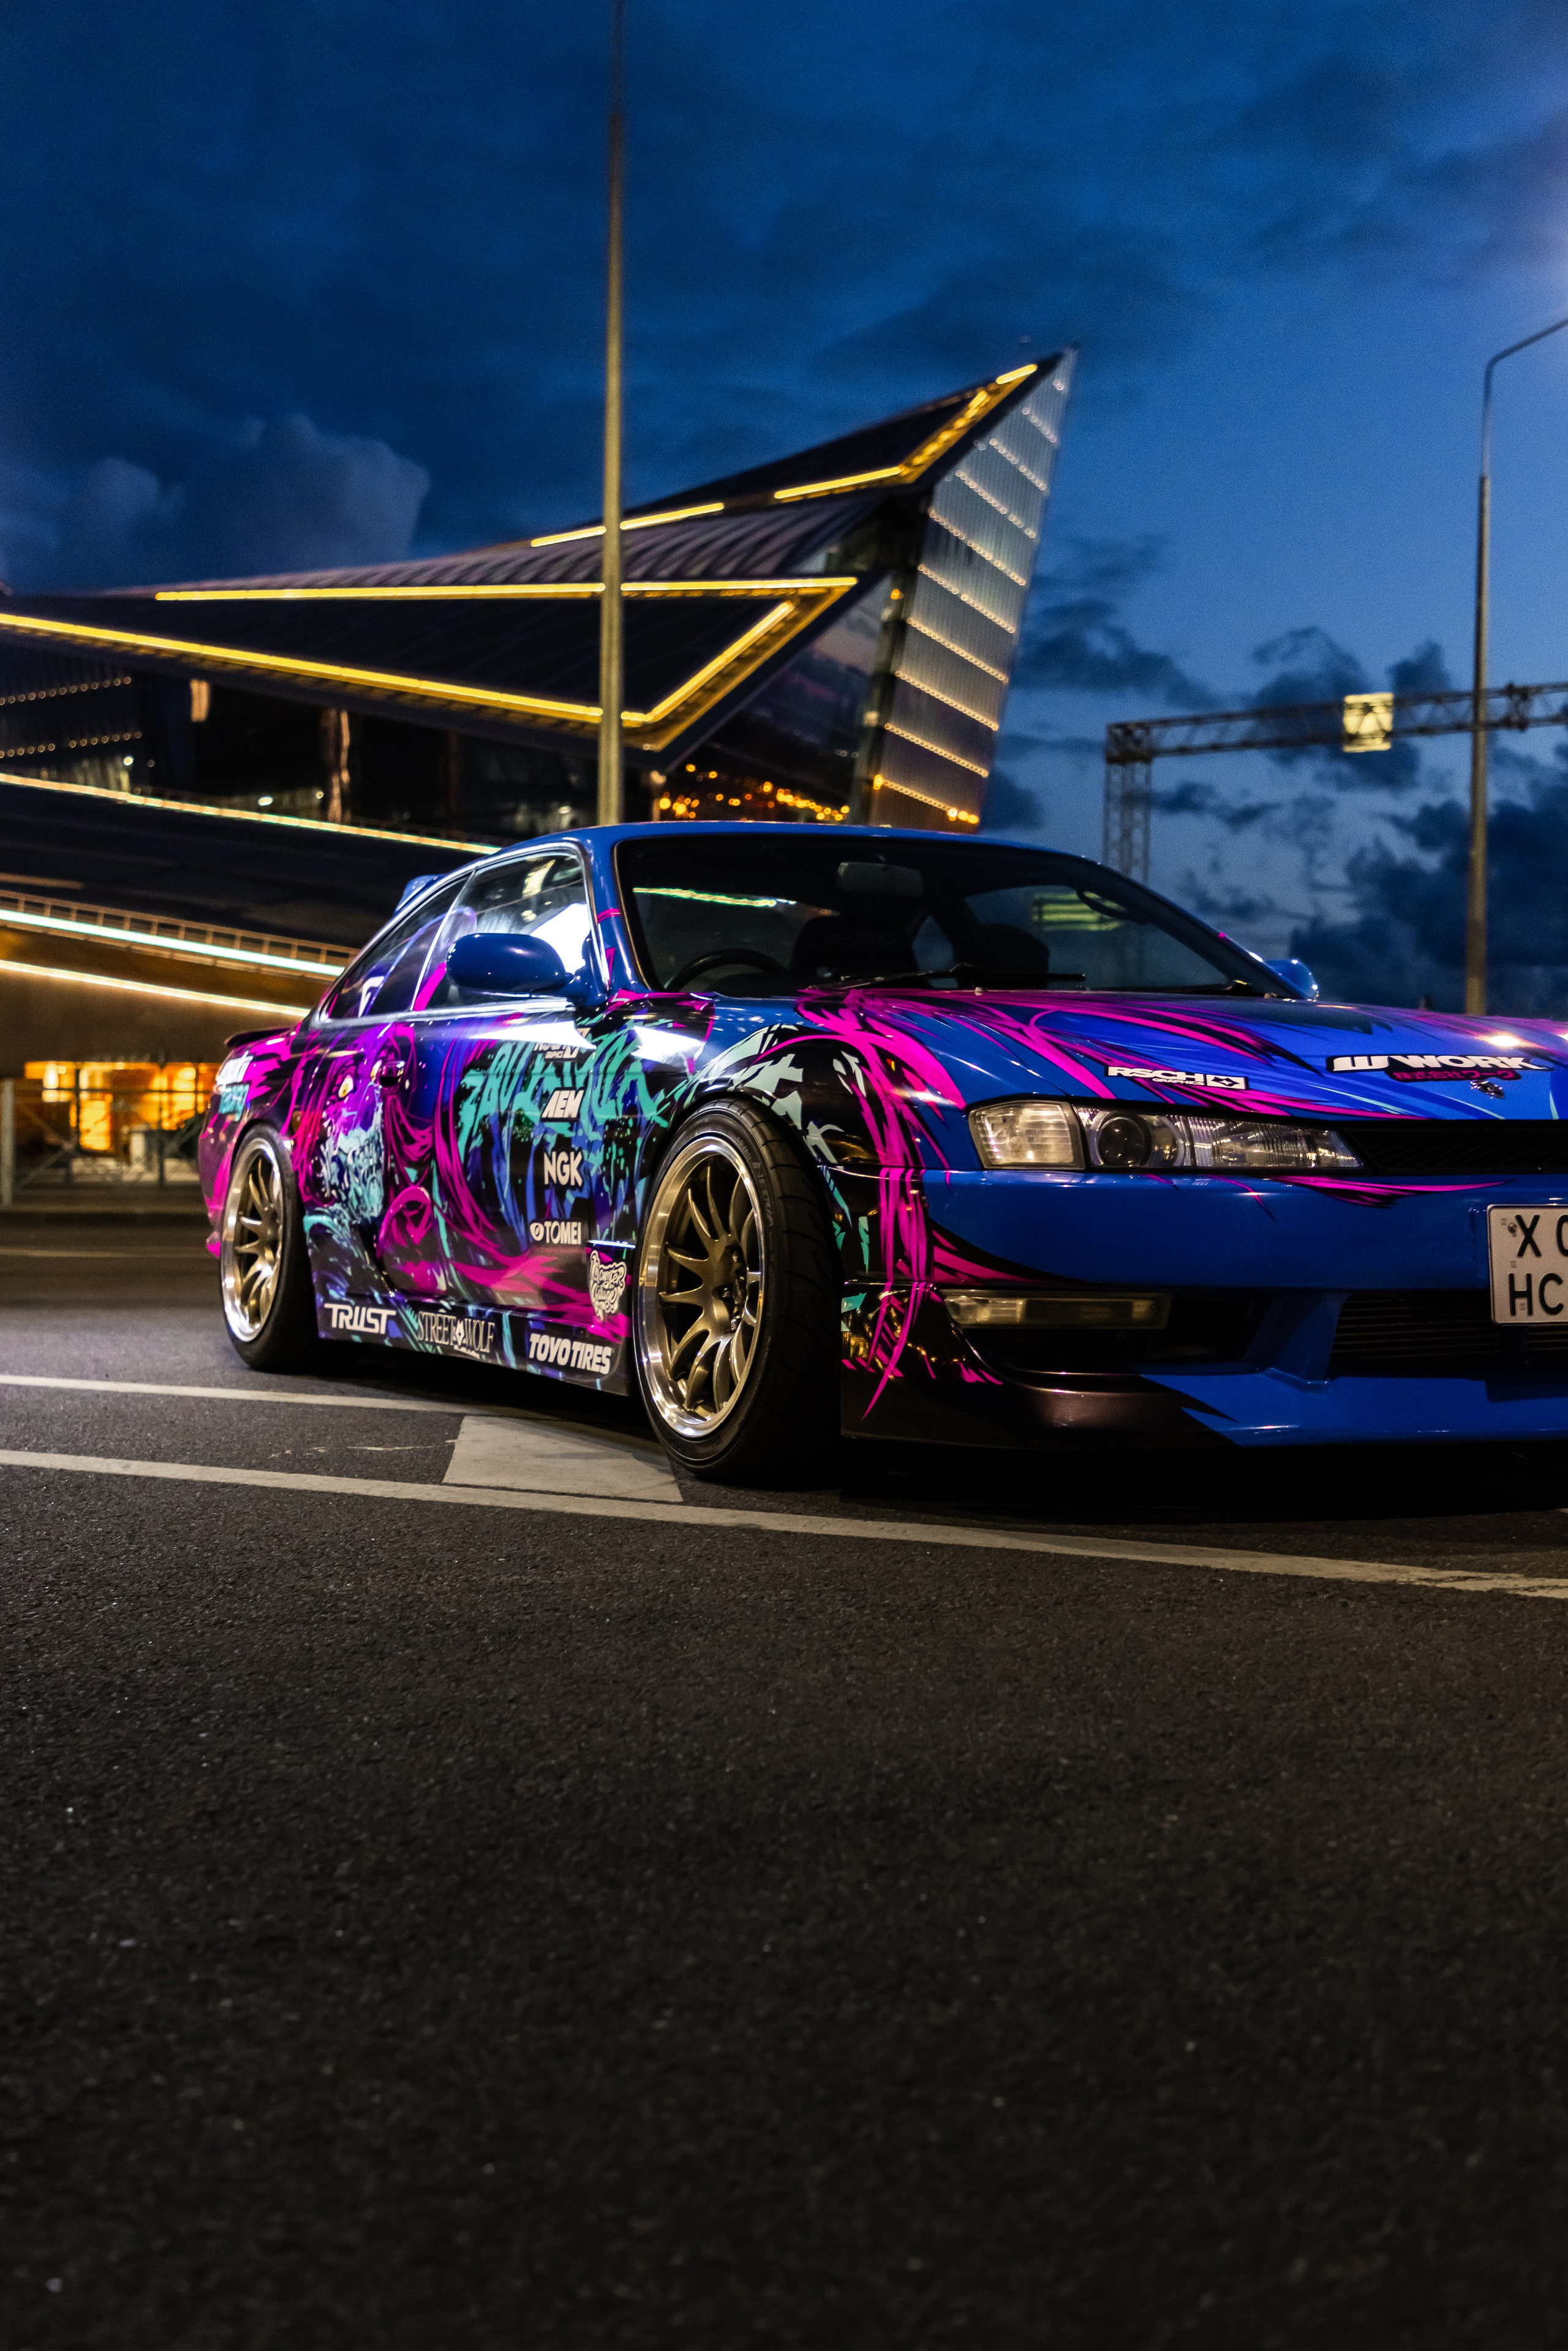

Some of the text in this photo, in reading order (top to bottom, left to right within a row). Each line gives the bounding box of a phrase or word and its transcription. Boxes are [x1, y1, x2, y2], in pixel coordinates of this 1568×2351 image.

[1107, 1066, 1204, 1082] RSCH
[541, 1090, 585, 1119] AEM
[543, 1151, 583, 1187] NGK
[544, 1221, 582, 1245] TOMEI
[323, 1304, 397, 1335] TRUST
[418, 1311, 496, 1353] STREET WOLF
[529, 1333, 612, 1375] TOYO TIRES
